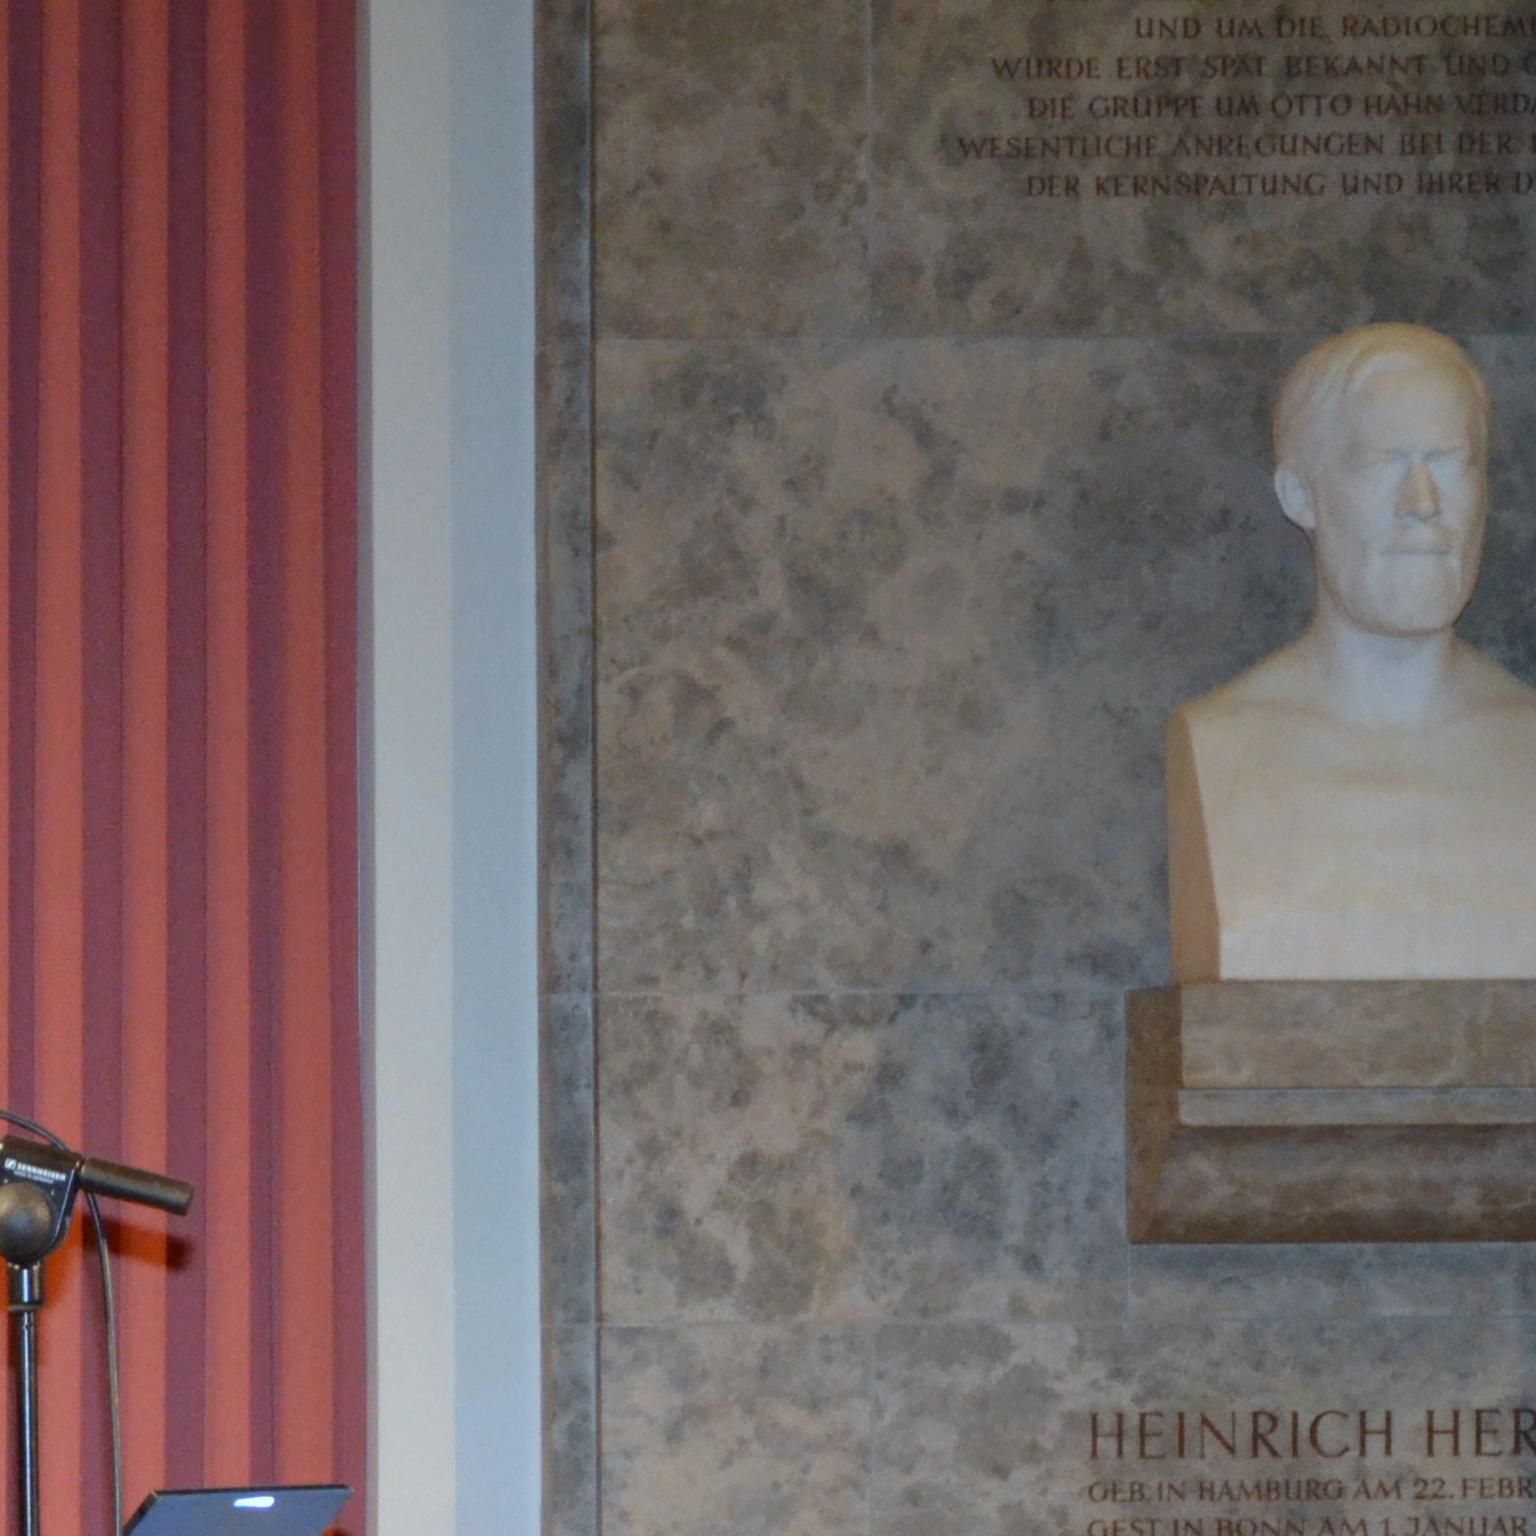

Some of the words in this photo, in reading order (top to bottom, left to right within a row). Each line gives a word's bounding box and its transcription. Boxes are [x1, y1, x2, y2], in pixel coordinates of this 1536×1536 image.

[1134, 14, 1202, 40] UND
[1215, 14, 1265, 40] UM
[1276, 14, 1325, 39] DIE
[991, 56, 1101, 80] WURDE
[1116, 56, 1187, 80] ERST
[1285, 54, 1429, 79] BEKANNT
[1444, 53, 1511, 78] UND
[1027, 95, 1075, 120] DIE
[1087, 95, 1202, 119] GRUPPE
[1215, 94, 1261, 119] UM
[1271, 93, 1353, 118] OTTO
[1363, 92, 1443, 118] HAHN
[957, 135, 1158, 160] WESENTLICHE
[1173, 133, 1384, 159] ANREGUNGEN
[1400, 132, 1443, 157] BEI
[1458, 131, 1513, 156] DER
[1026, 174, 1081, 199] DER
[1094, 172, 1326, 198] KERNSPALTUNG
[1341, 172, 1404, 197] UND
[1416, 171, 1502, 196] IHRER
[1089, 1408, 1393, 1461] HEINRICH
[1425, 1407, 1536, 1458] HER
[1158, 1480, 1186, 1503] IN
[1198, 1478, 1343, 1502] HAMBURG
[1352, 1477, 1403, 1501] AM
[1413, 1477, 1454, 1500] 22.
